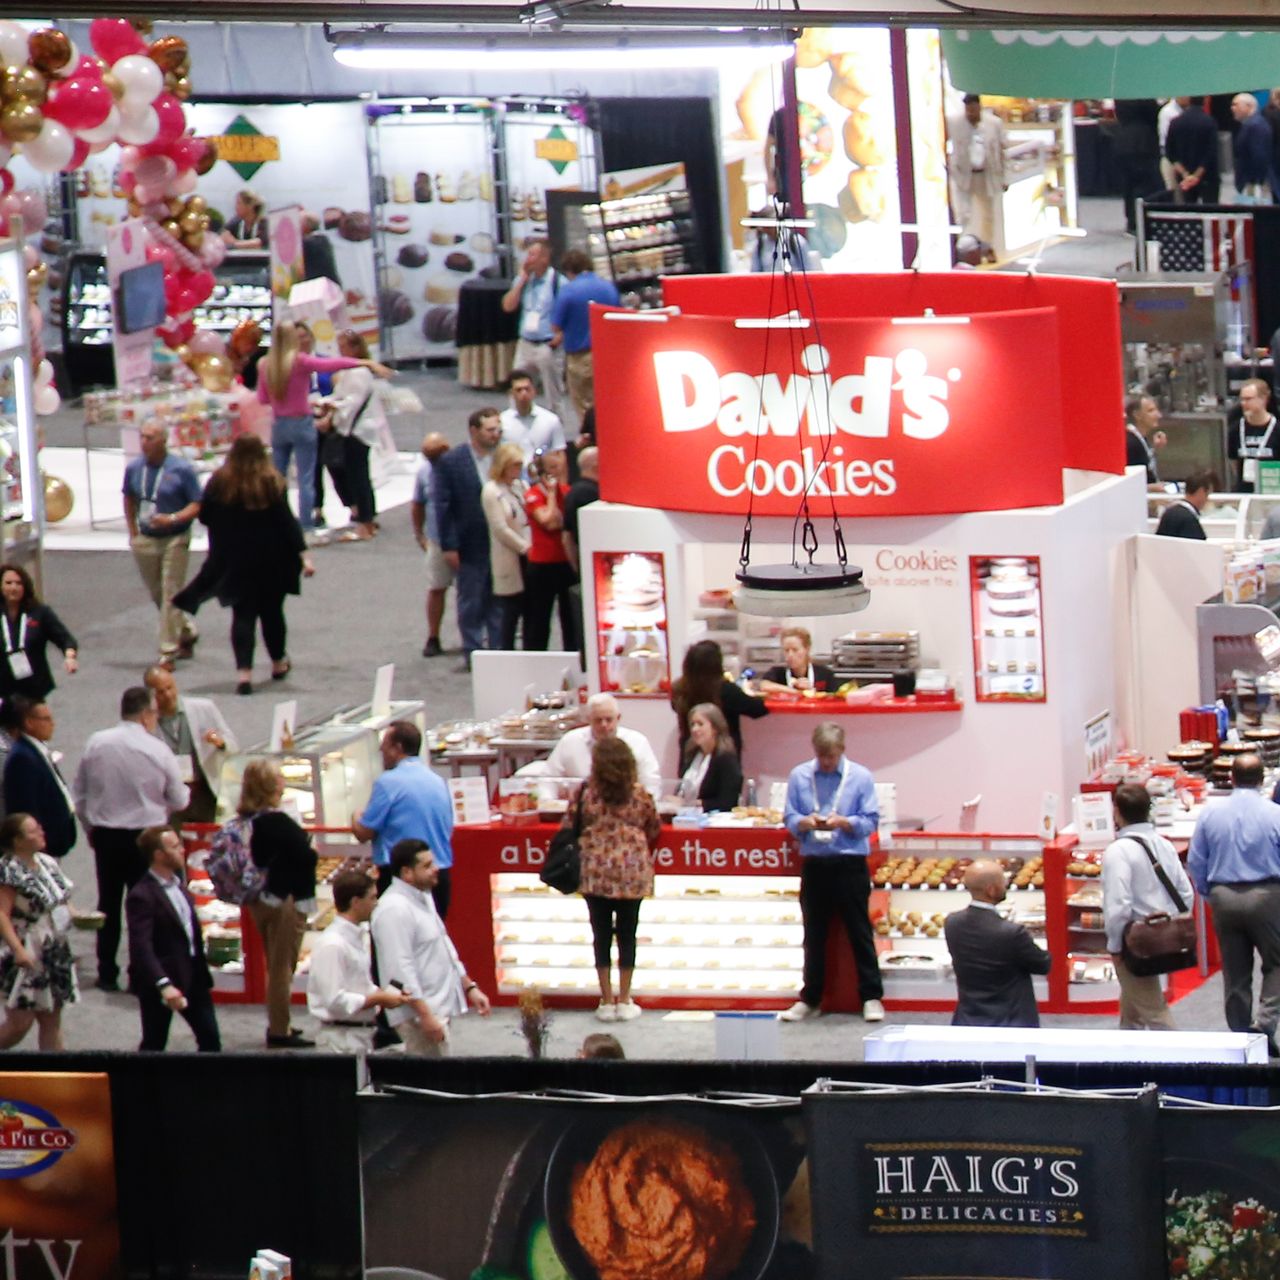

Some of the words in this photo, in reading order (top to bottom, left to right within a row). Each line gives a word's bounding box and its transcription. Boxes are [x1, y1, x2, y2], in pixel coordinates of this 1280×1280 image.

[654, 344, 949, 440] David's
[707, 444, 897, 498] Cookies
[876, 549, 958, 572] Cookies
[683, 838, 724, 867] the
[873, 1155, 1080, 1198] HAIG'S
[901, 1206, 1058, 1223] DELICACIES
